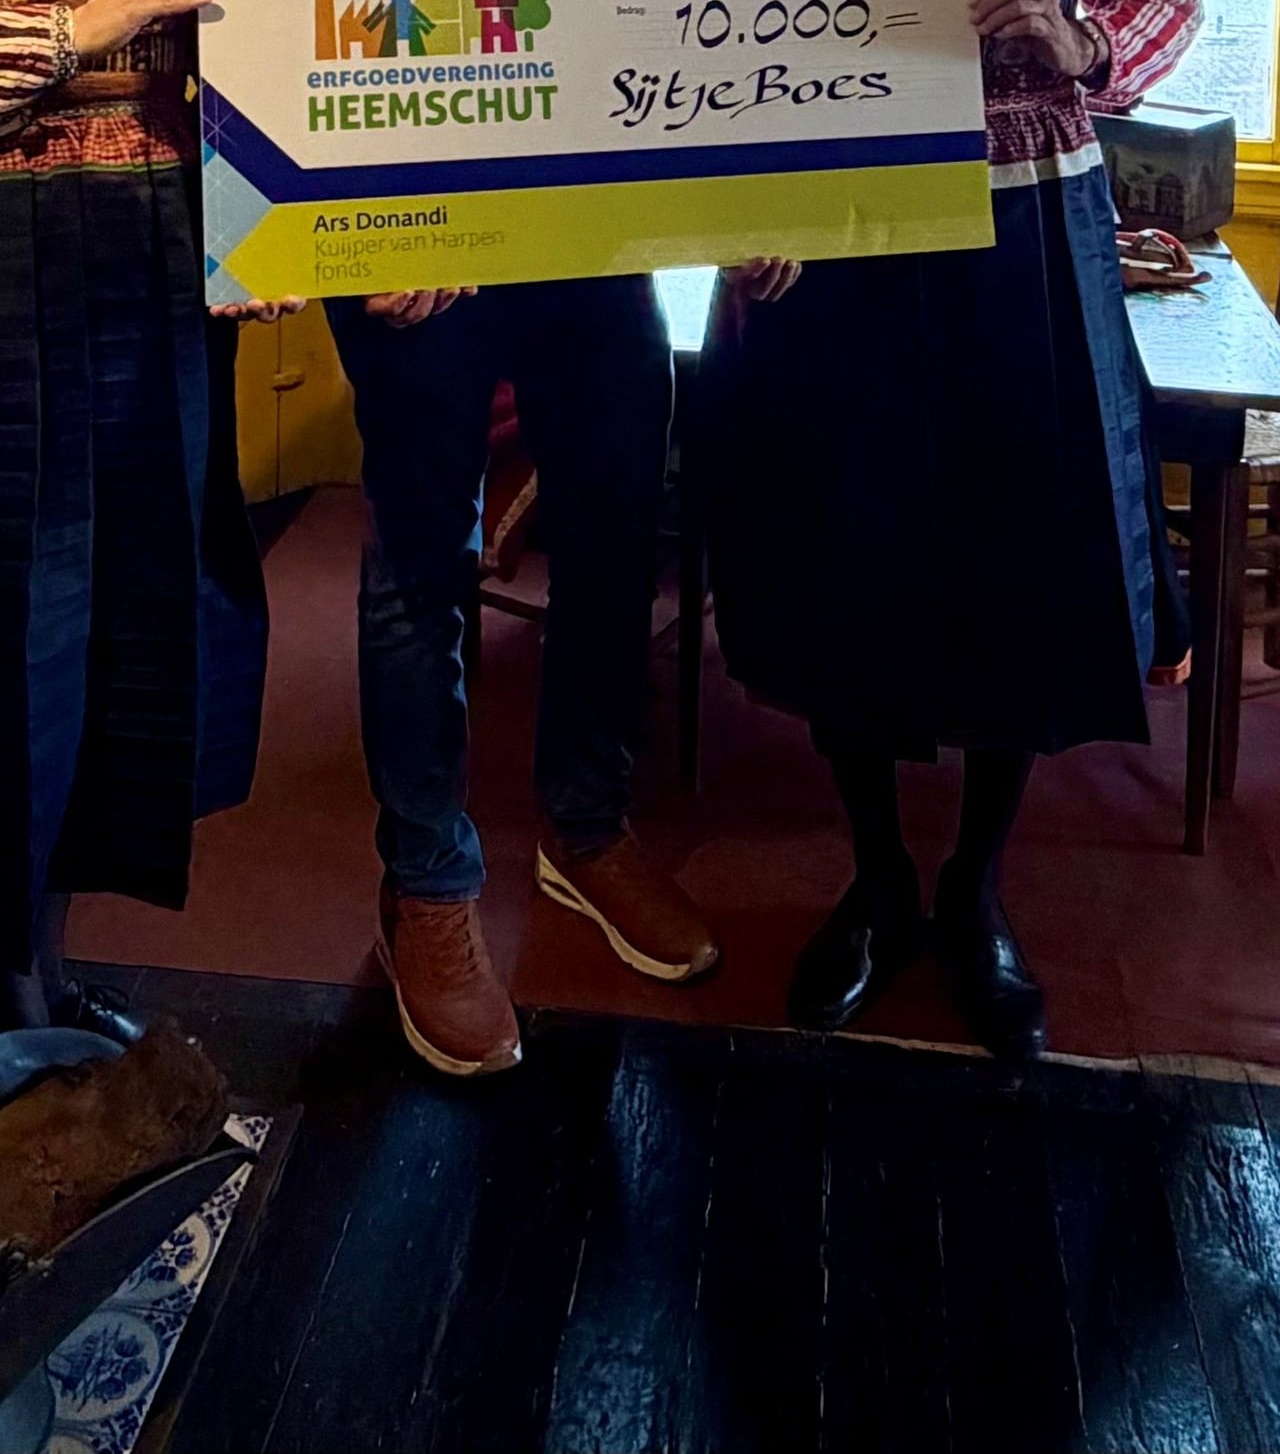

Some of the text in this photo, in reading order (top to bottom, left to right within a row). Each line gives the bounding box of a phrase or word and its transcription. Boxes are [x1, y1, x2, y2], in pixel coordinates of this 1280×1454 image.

[730, 64, 893, 119] Boes
[307, 85, 559, 132] HEEMSCHUT
[313, 205, 448, 234] Ars Donandi
[389, 233, 426, 252] van
[314, 260, 373, 286] fonds
